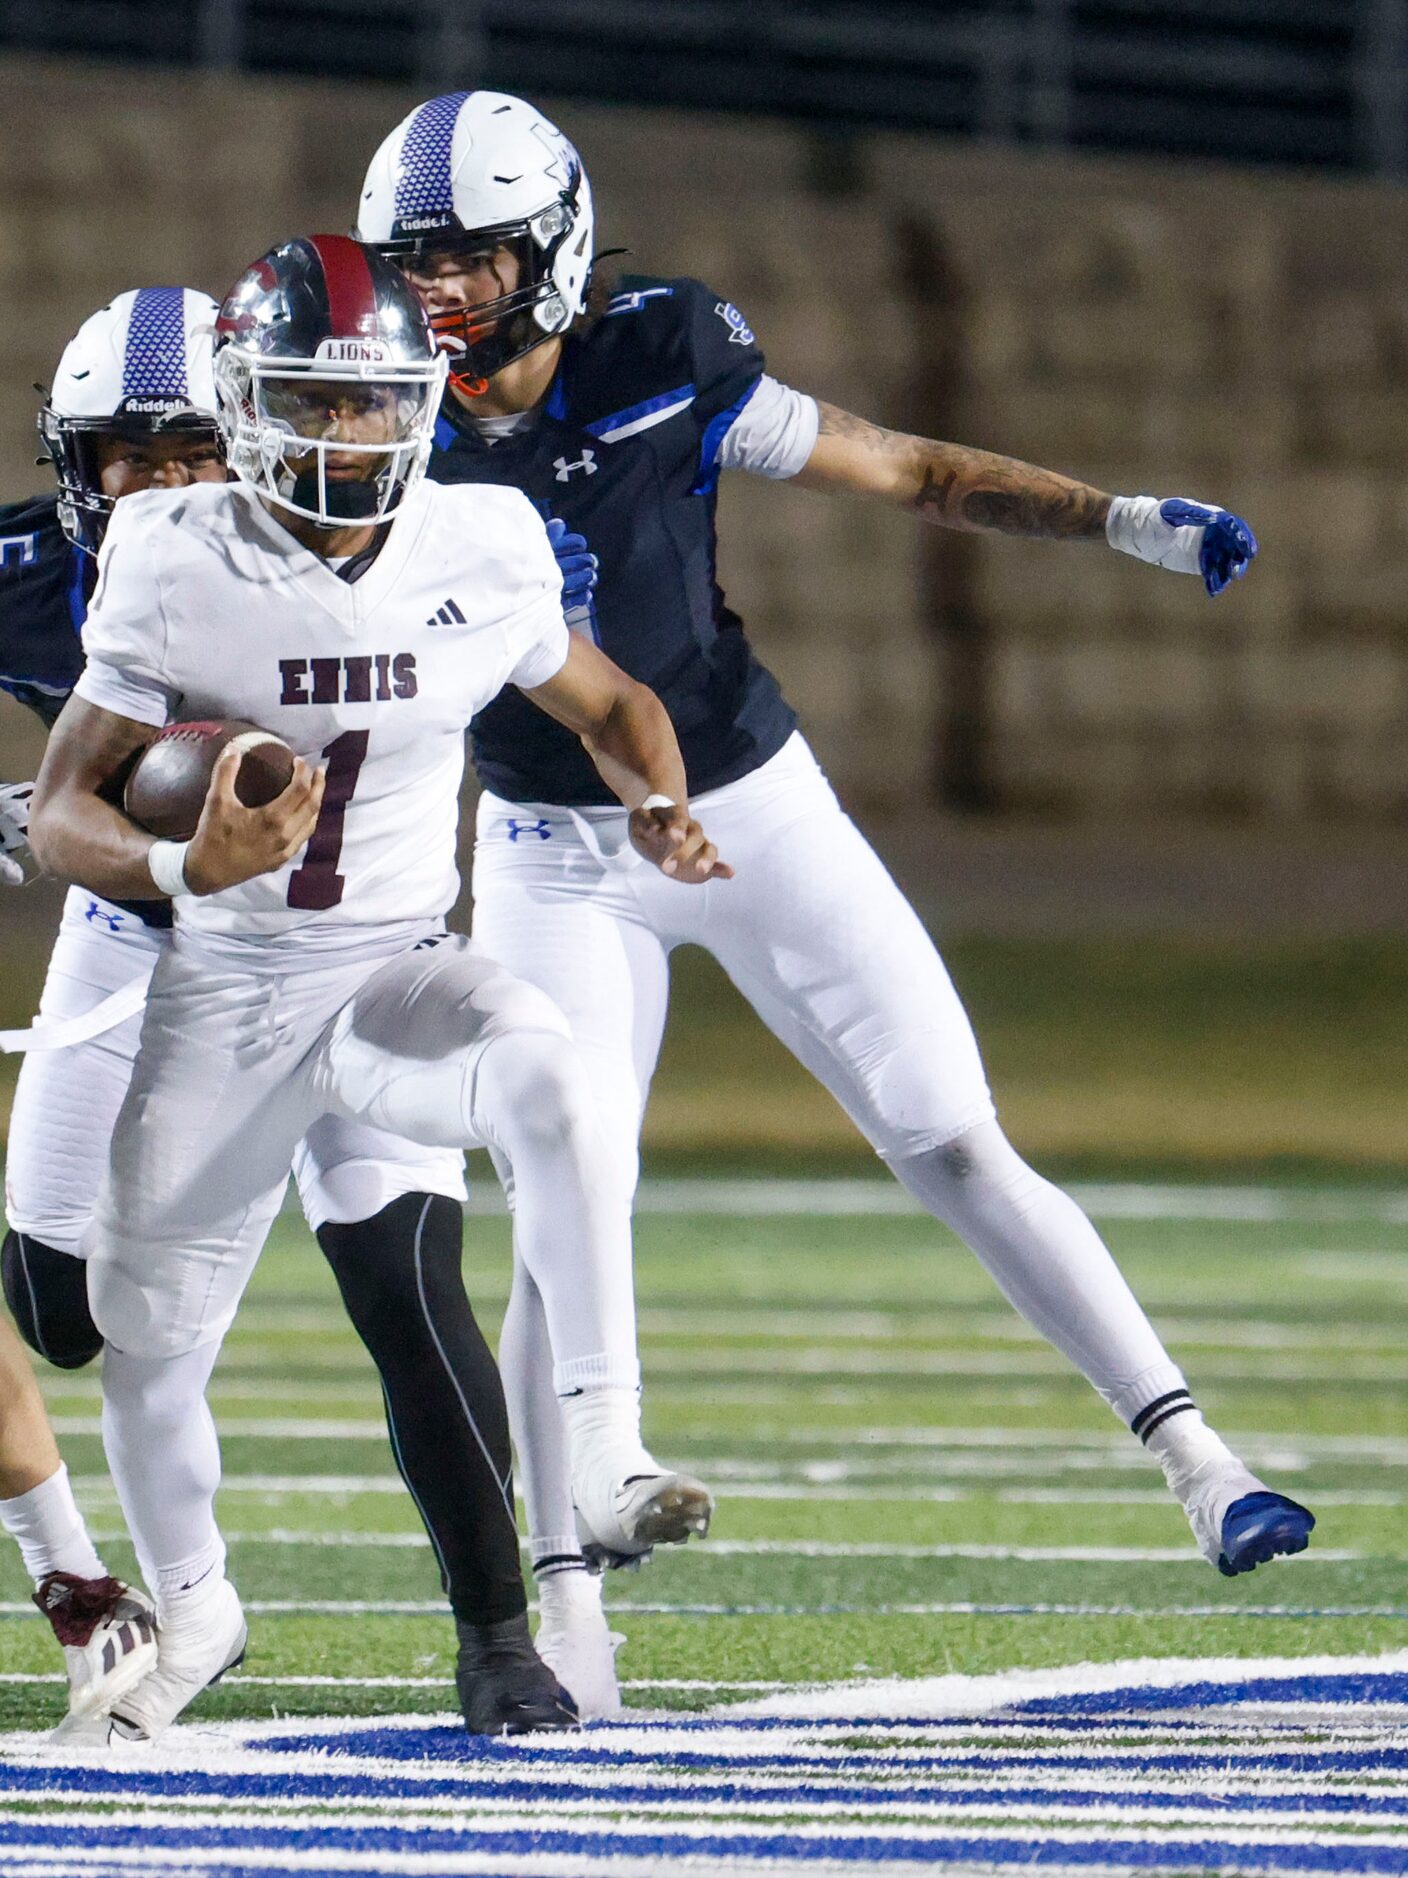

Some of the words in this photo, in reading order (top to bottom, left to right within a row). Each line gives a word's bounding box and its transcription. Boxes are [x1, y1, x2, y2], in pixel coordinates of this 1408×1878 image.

[327, 343, 384, 362] LIONS
[278, 652, 418, 706] ENNIS
[286, 728, 370, 911] 1
